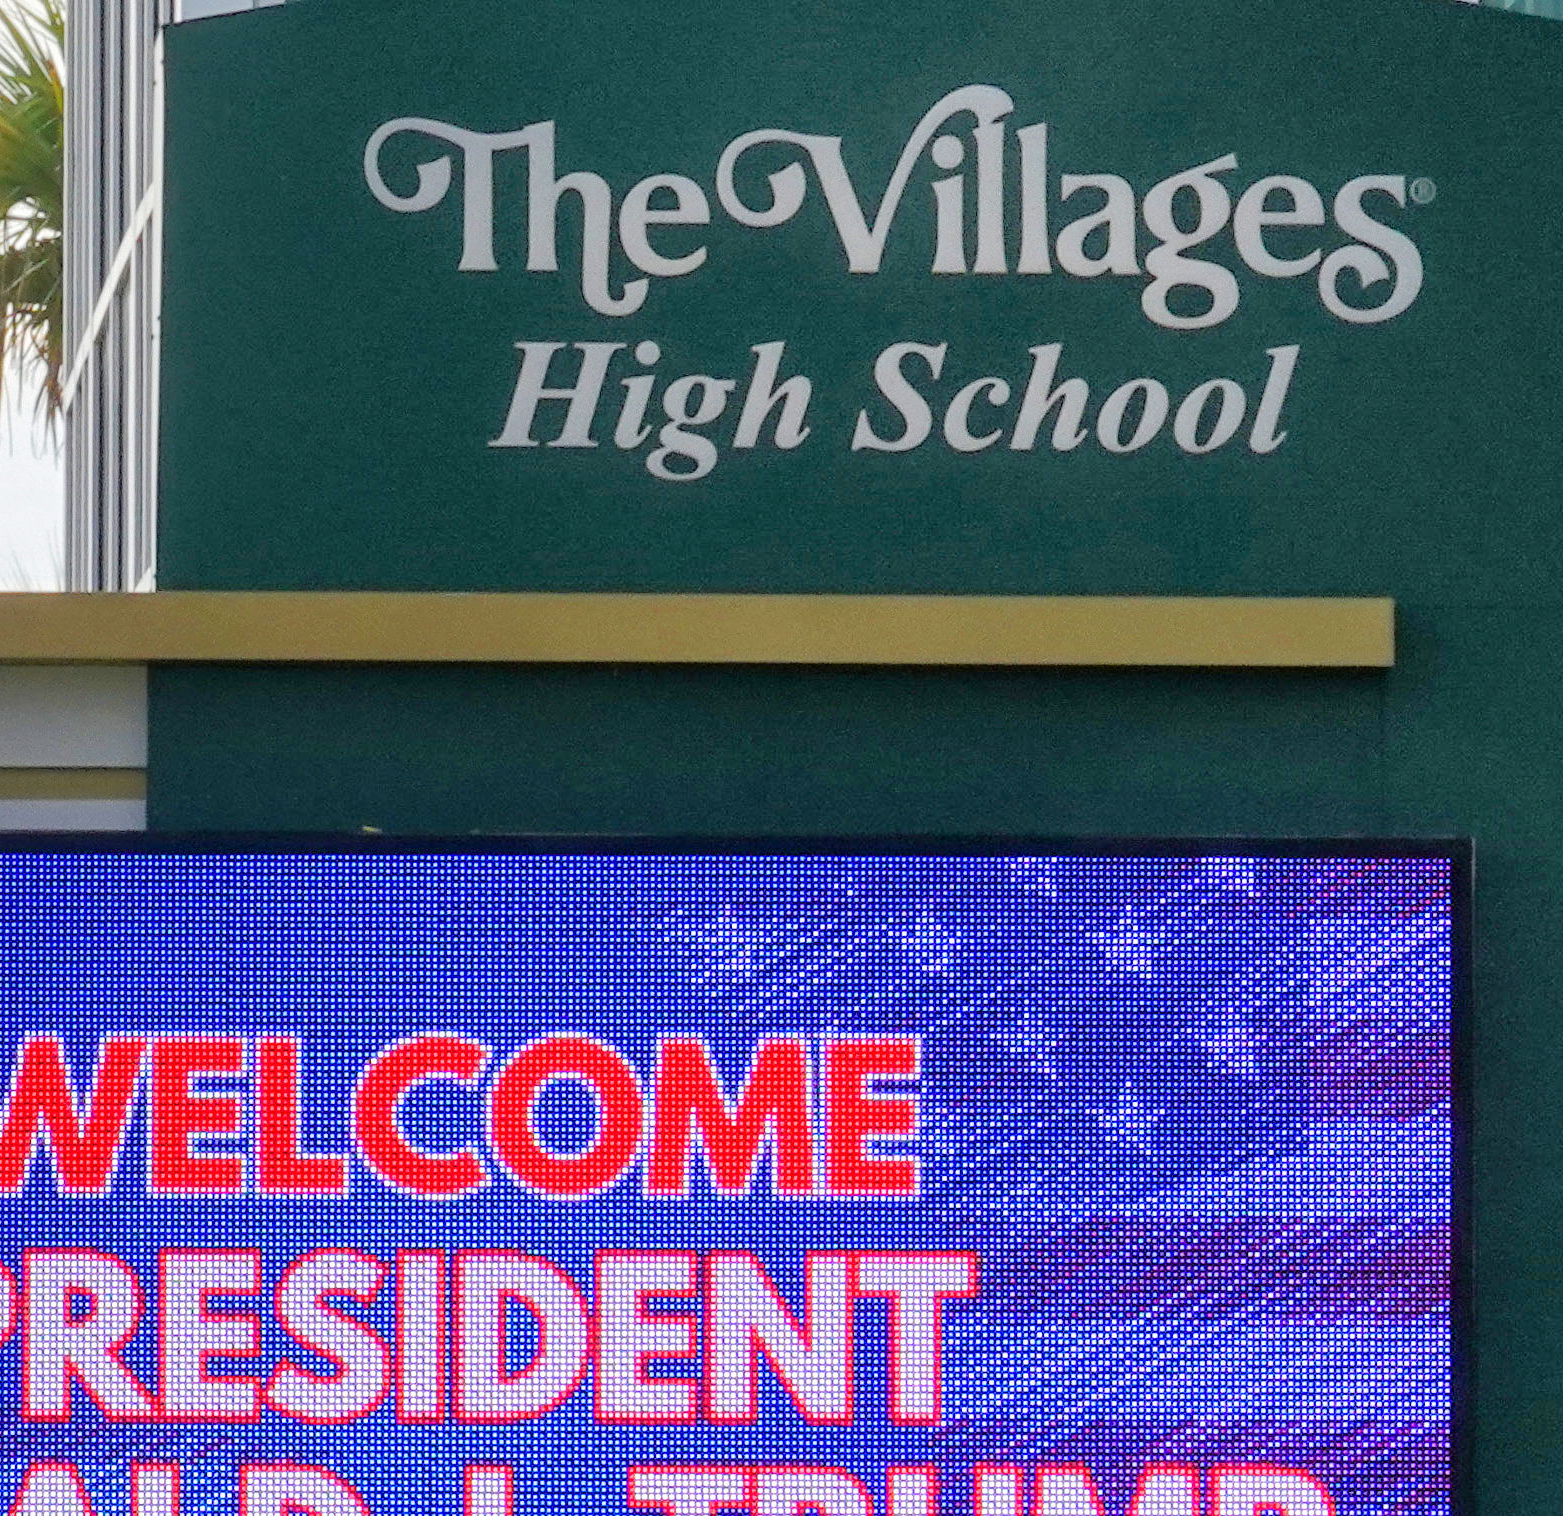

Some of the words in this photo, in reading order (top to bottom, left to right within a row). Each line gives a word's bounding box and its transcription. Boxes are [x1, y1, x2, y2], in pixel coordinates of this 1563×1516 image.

[362, 116, 711, 318] The
[486, 340, 812, 482] High
[851, 340, 1301, 455] School
